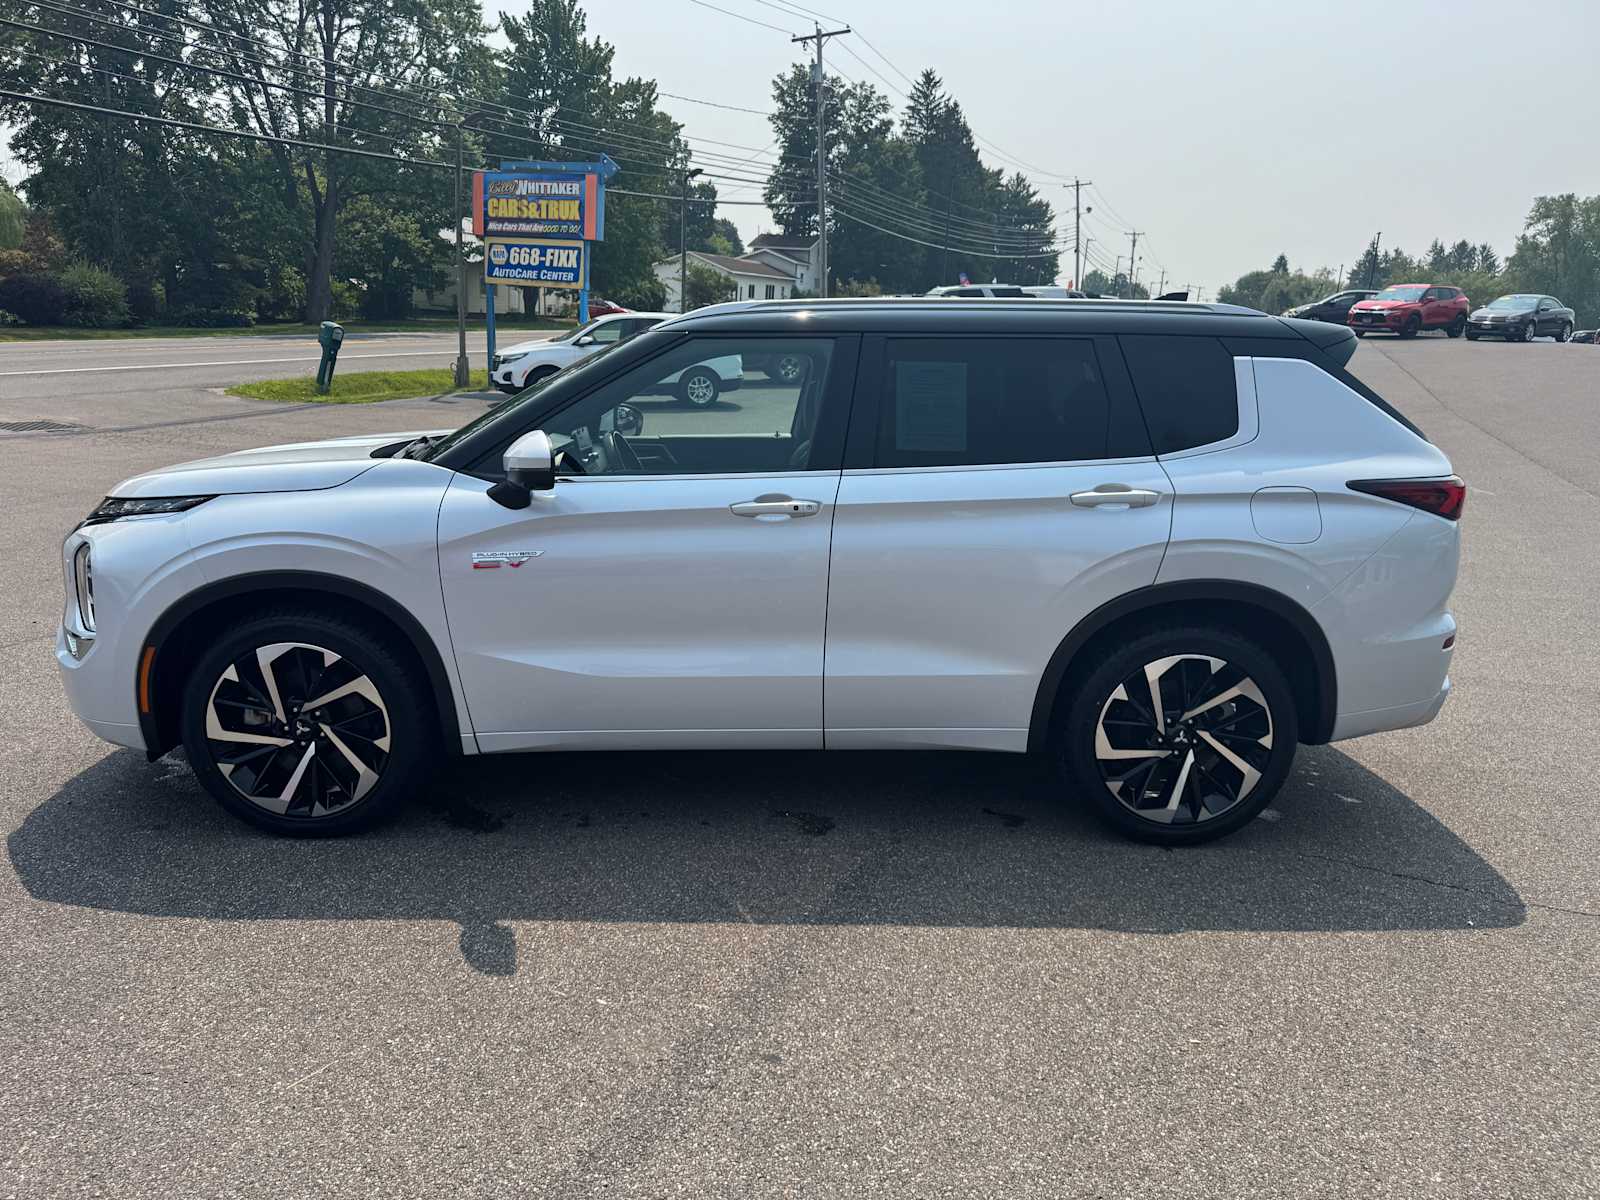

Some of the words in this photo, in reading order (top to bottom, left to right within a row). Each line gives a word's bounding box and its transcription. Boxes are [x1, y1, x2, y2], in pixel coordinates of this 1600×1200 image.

[515, 180, 579, 195] WHITTAKER
[502, 222, 518, 232] Cars
[518, 223, 532, 232] That
[510, 247, 578, 268] 668-FIXX
